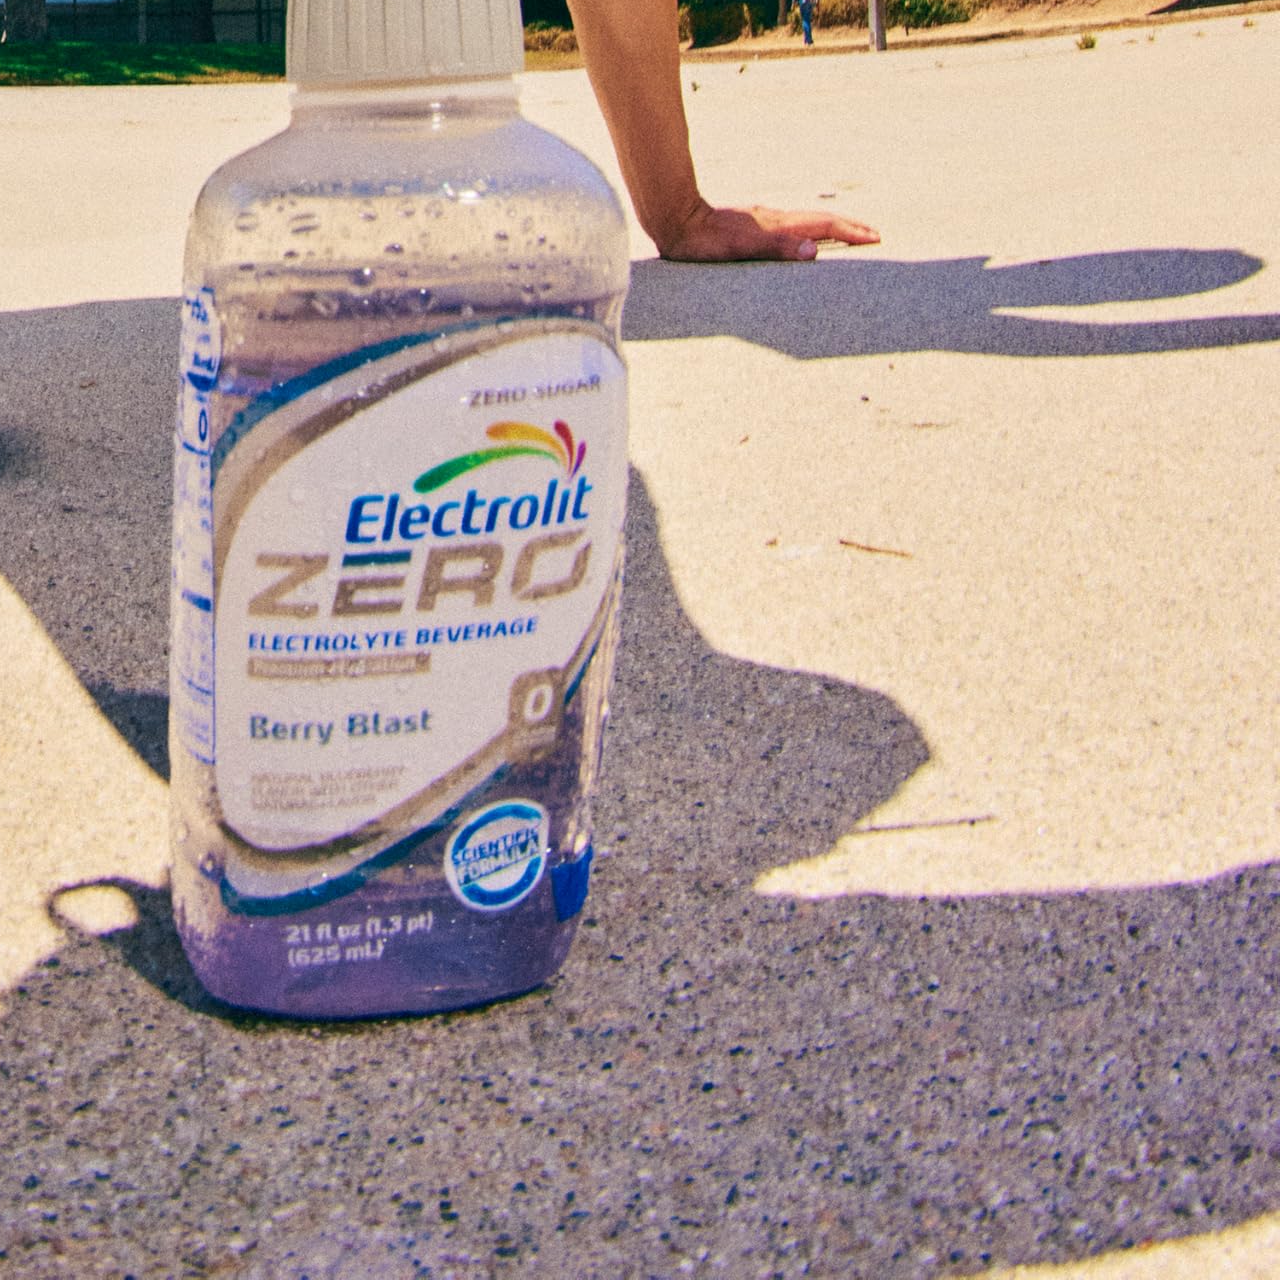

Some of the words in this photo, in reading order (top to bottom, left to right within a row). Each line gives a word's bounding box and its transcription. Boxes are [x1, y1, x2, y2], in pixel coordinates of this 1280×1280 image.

[469, 388, 527, 407] ZERO
[345, 475, 593, 544] Electrolit
[248, 527, 593, 618] ZERO
[248, 629, 409, 652] ELECTROLYTE
[415, 615, 539, 646] BEVERAGE
[249, 714, 334, 745] Berry
[347, 708, 431, 737] Blast
[285, 923, 311, 943] 21
[317, 922, 332, 940] fl
[337, 923, 361, 940] oz
[366, 915, 403, 937] (1.3
[287, 943, 341, 967] (625
[345, 937, 385, 961] mL)
